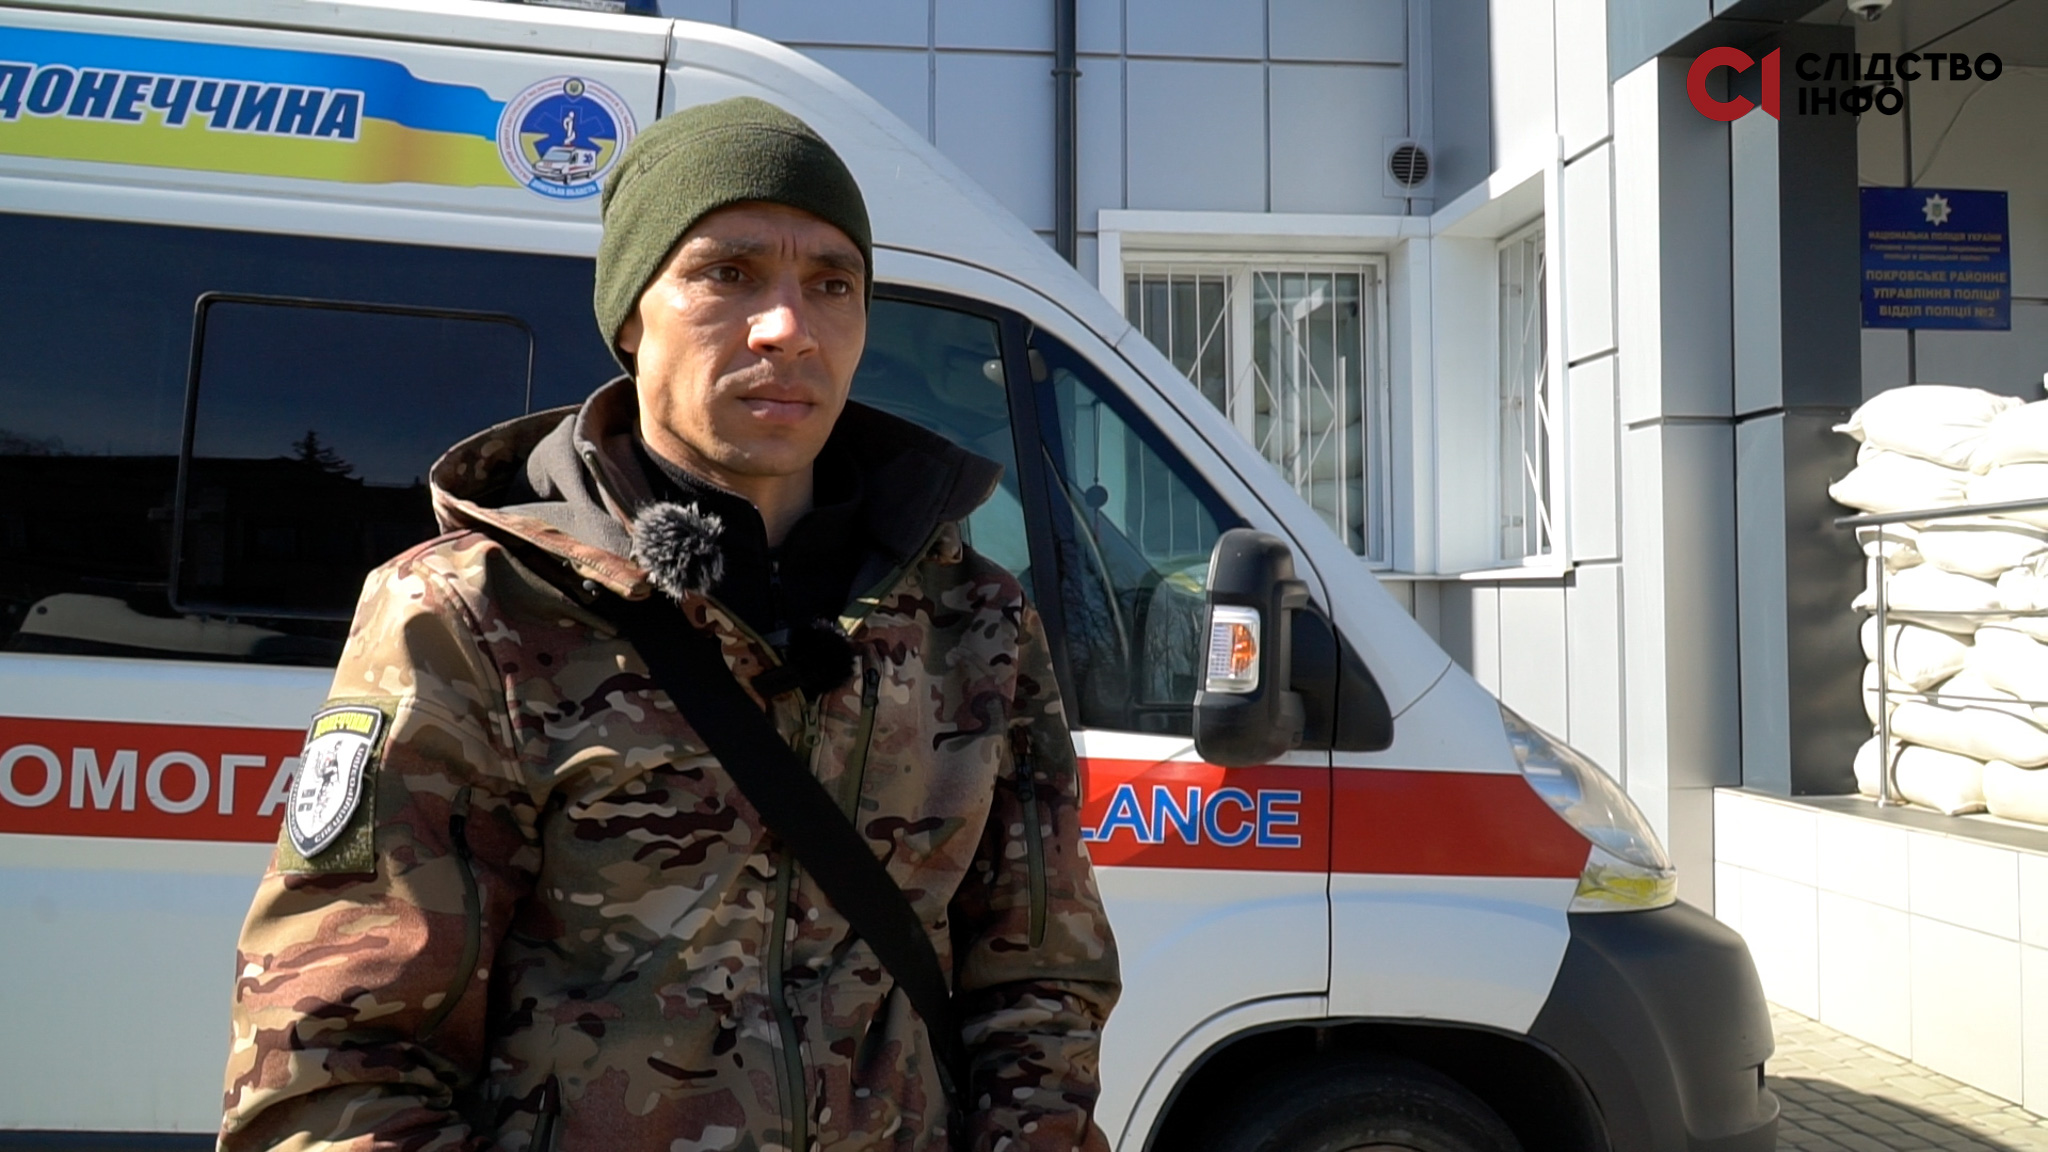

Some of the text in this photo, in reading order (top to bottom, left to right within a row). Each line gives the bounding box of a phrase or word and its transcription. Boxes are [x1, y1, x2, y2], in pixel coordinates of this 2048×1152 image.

[0, 62, 363, 142] ДОНЕЧЧИНА
[1866, 270, 2007, 283] ПОКРОВСЬКЕ РАЙОННЕ
[1873, 287, 2000, 301] УПРАВЛІННЯ ПОЛІЦІЇ
[1879, 305, 1922, 318] ВІДДІЛ
[1925, 306, 1971, 319] ПОЛІЦІЇ
